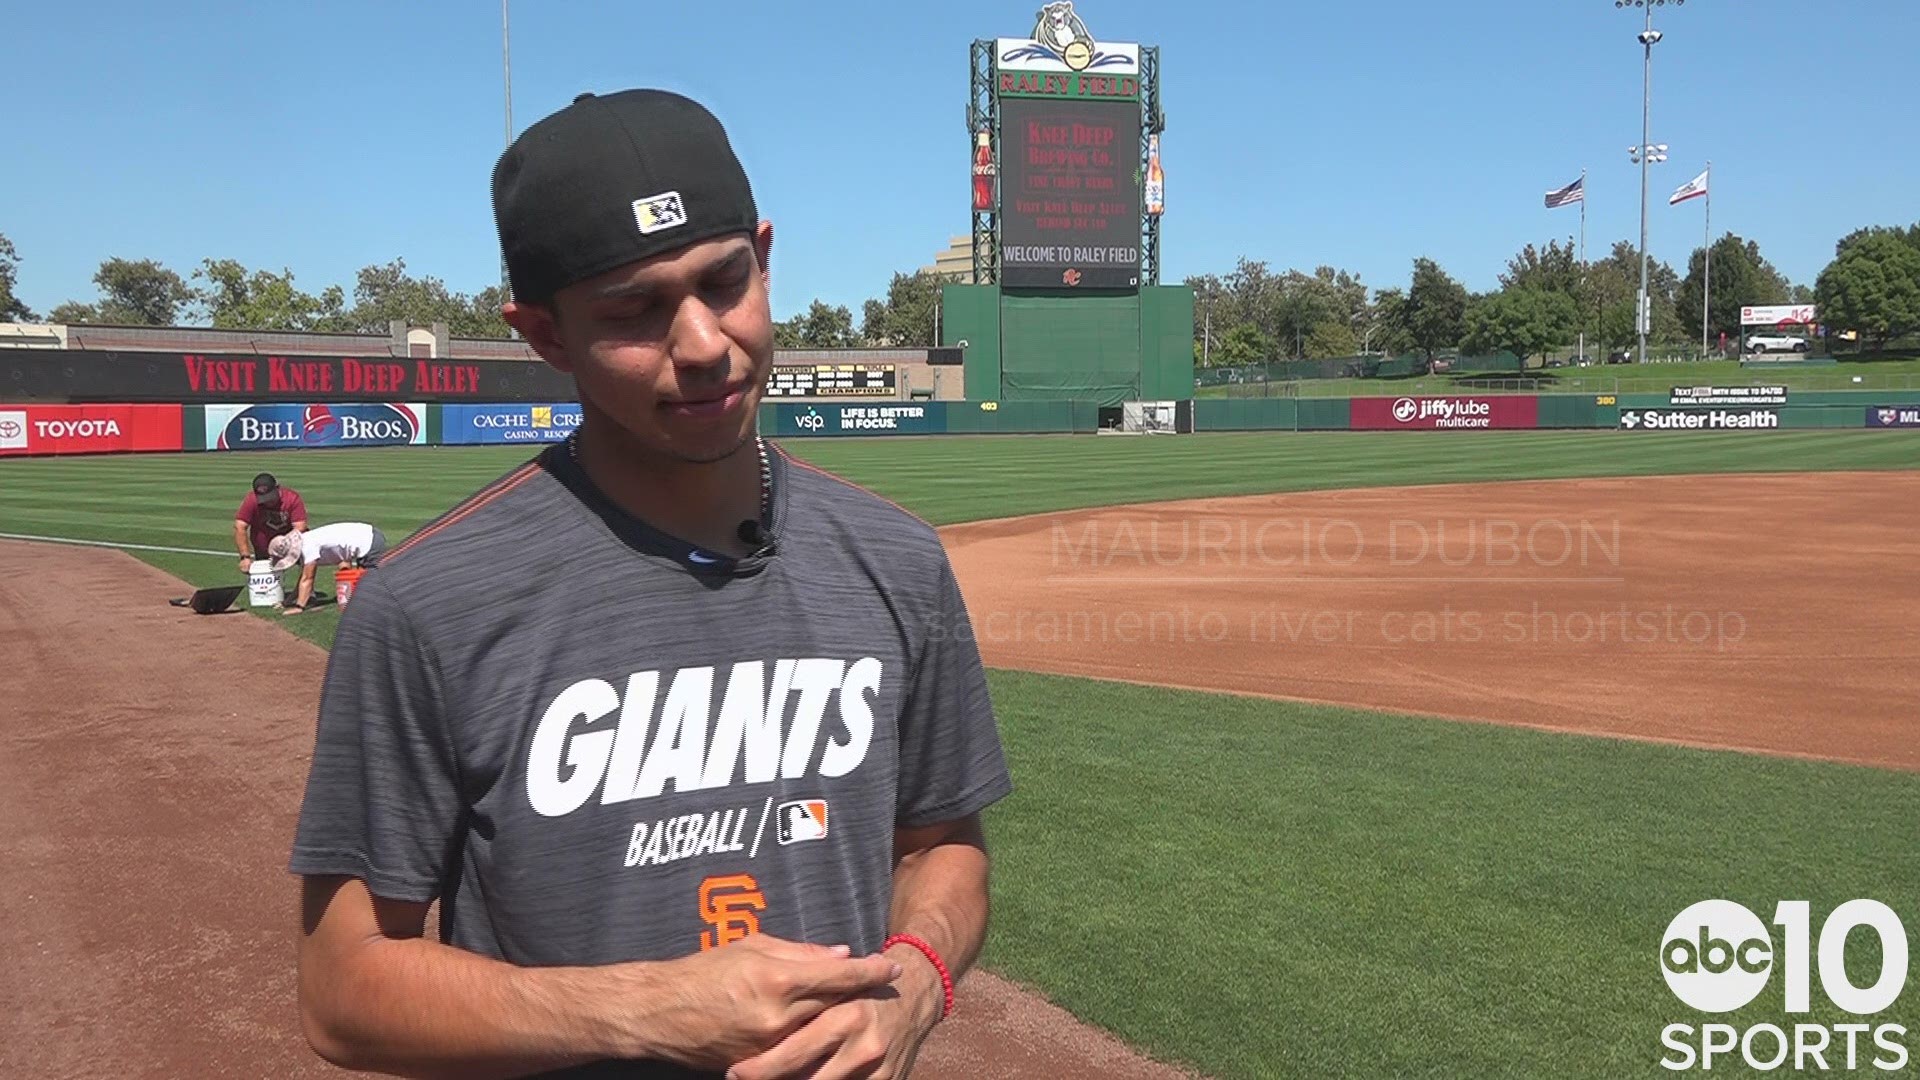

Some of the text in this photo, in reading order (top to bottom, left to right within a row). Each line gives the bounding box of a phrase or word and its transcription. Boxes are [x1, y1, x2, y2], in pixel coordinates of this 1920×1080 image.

[1000, 73, 1139, 96] RALEY FIELD
[1029, 122, 1114, 146] KNEE DEEP
[1003, 246, 1138, 263] WELCOME TO RALEY FIELD
[184, 354, 480, 393] VISIT KNEE DEEP ALLEY
[1674, 388, 1692, 396] TEXT
[1750, 388, 1760, 396] TO
[980, 402, 999, 411] 403
[1596, 396, 1616, 406] 380
[473, 414, 528, 428] CACHE
[841, 407, 925, 419] LIFE IS BETTER
[1643, 410, 1778, 428] Sutter Health
[34, 420, 121, 438] TOYOTA
[240, 416, 407, 441] BELL BROS.
[794, 415, 825, 432] vsp
[841, 419, 855, 429] IN
[1435, 418, 1490, 427] multicare
[504, 430, 539, 440] CASINO
[525, 657, 884, 818] GIANTS
[623, 808, 748, 868] BASEBALL
